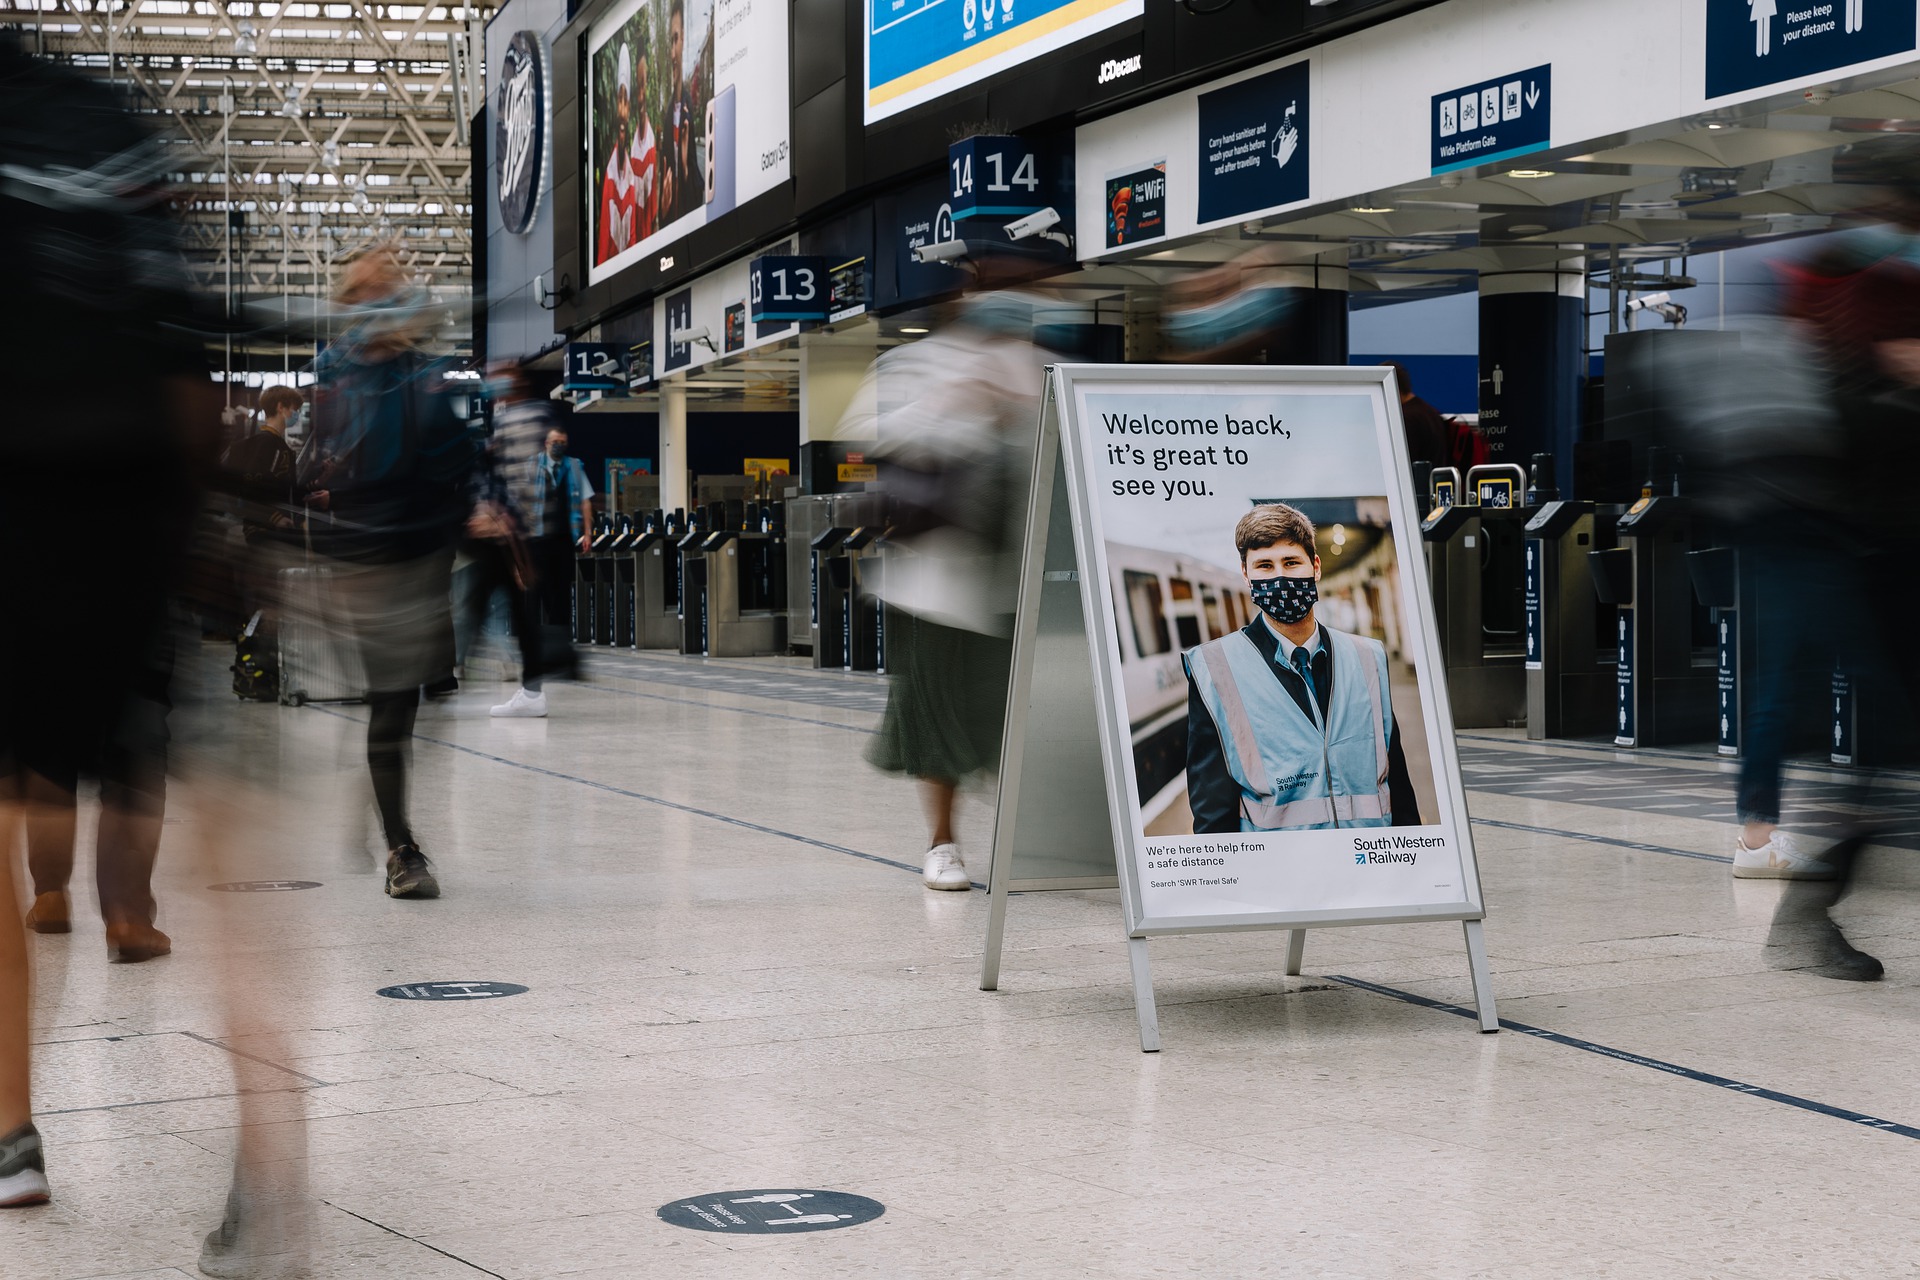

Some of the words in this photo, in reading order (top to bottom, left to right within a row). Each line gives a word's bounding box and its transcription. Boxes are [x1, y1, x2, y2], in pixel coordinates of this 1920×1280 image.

[1786, 8, 1812, 24] Please
[1813, 4, 1832, 20] keep
[1783, 29, 1801, 45] your
[1802, 20, 1835, 38] distance
[1098, 54, 1141, 84] JCDecaux
[1209, 138, 1222, 148] Carry
[1223, 132, 1235, 144] hand
[1235, 127, 1256, 140] sanitiser
[1256, 122, 1266, 134] and
[1209, 150, 1222, 162] wash
[1222, 148, 1234, 161] your
[1234, 143, 1249, 155] hands
[1249, 139, 1266, 151] before
[1440, 144, 1455, 157] Wide
[1456, 139, 1481, 154] Platform
[1482, 136, 1496, 147] Gate
[952, 154, 973, 198] 14
[985, 152, 1039, 192] 14
[1214, 164, 1224, 175] and
[1224, 161, 1236, 173] after
[1144, 177, 1165, 201] WiFi
[752, 270, 762, 304] 13
[772, 268, 816, 301] 13
[1102, 413, 1219, 435] Welcome
[1225, 414, 1291, 439] back,
[1107, 443, 1145, 465] it’s
[1153, 446, 1217, 471] great
[1223, 446, 1248, 465] to
[1112, 479, 1155, 495] see
[1162, 480, 1214, 501] you.
[1276, 775, 1295, 785] South
[1294, 772, 1319, 781] Western
[1284, 780, 1307, 790] Railway
[1146, 846, 1176, 856] We're
[1179, 845, 1202, 854] here
[1204, 844, 1215, 853] to
[1217, 843, 1238, 854] help
[1241, 842, 1265, 851] from
[1353, 837, 1391, 851] South
[1392, 836, 1445, 848] Western
[1148, 861, 1154, 869] a
[1157, 858, 1178, 868] safe
[1181, 857, 1224, 867] distance
[1368, 851, 1417, 865] Railway
[1150, 880, 1176, 888] Search
